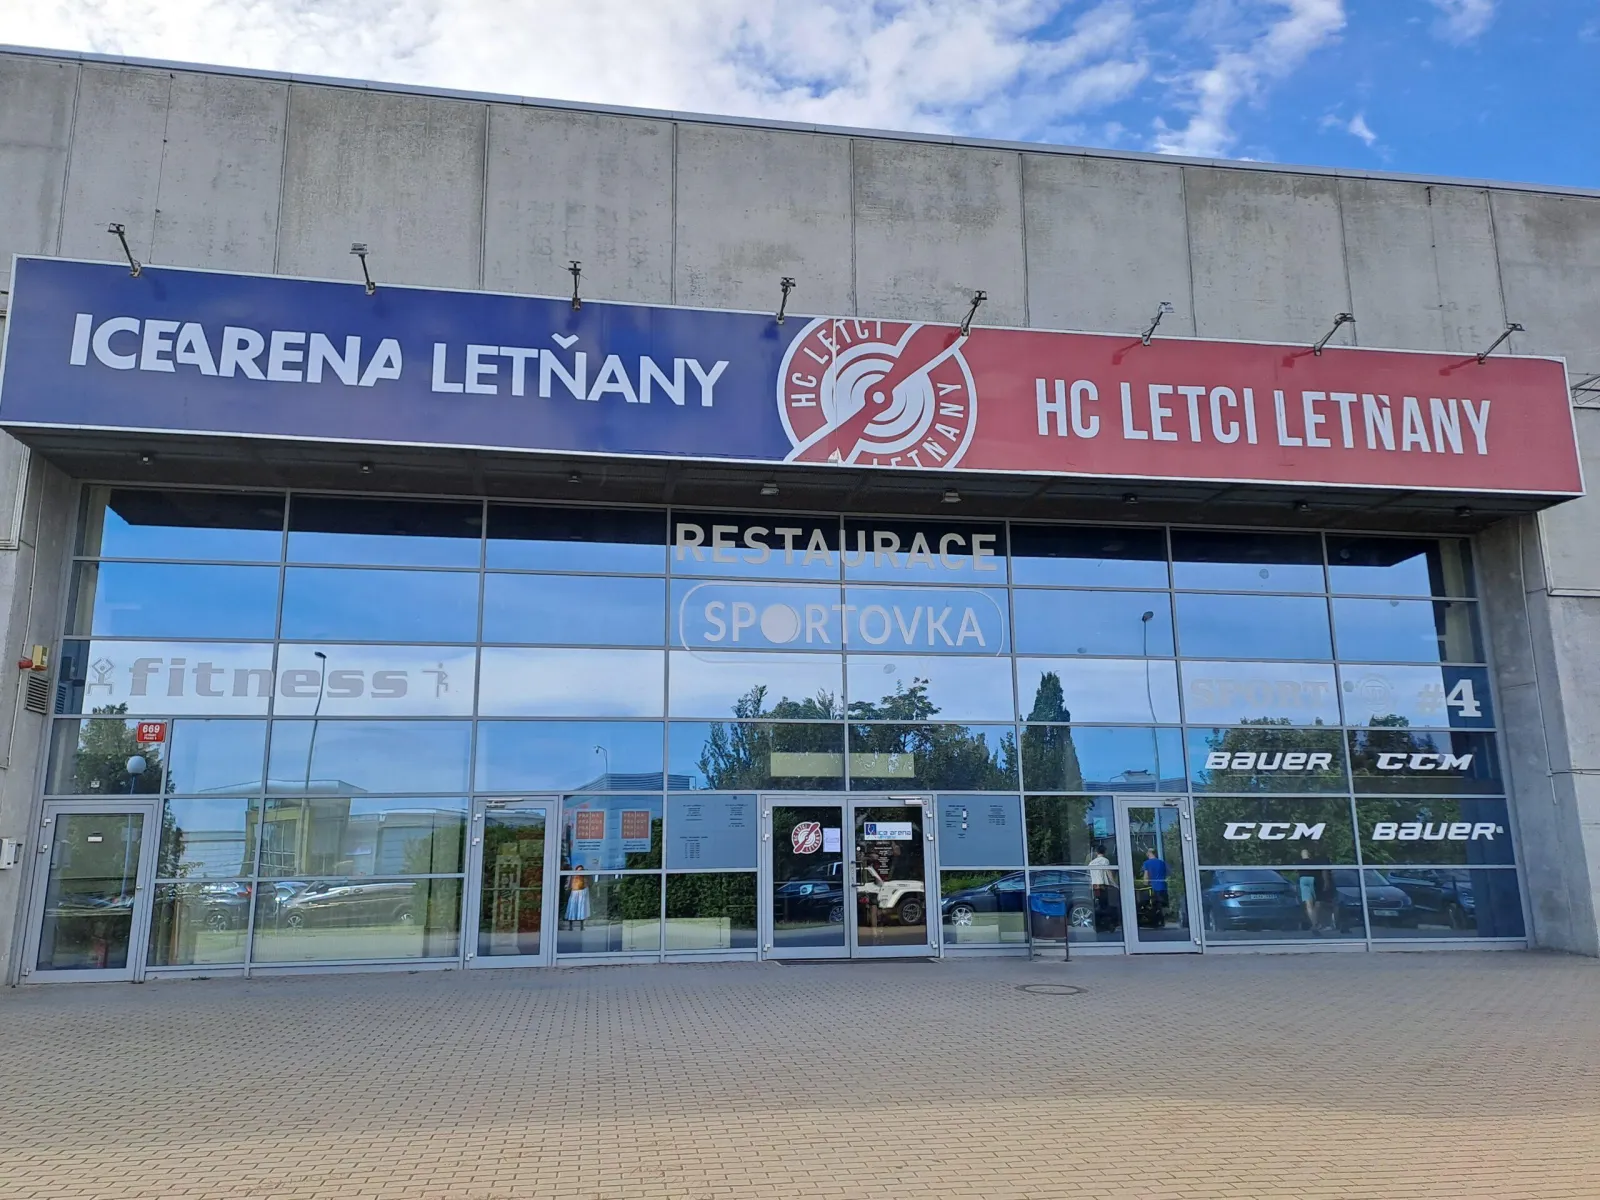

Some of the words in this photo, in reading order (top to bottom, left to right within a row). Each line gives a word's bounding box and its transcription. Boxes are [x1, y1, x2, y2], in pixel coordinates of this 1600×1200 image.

[70, 313, 402, 387] ICEARENA
[431, 333, 730, 407] LETŇANY
[791, 373, 817, 407] HC
[1035, 377, 1100, 438] HC
[1120, 381, 1258, 444] LETCI
[1273, 389, 1491, 455] LETŇANY
[675, 522, 998, 571] RESTAURACE
[703, 600, 987, 647] SPORTOVKA
[128, 657, 409, 699] fitness
[1190, 677, 1329, 709] SPORT
[142, 724, 160, 734] 669
[1376, 752, 1474, 771] CCM
[1222, 822, 1327, 840] CCM
